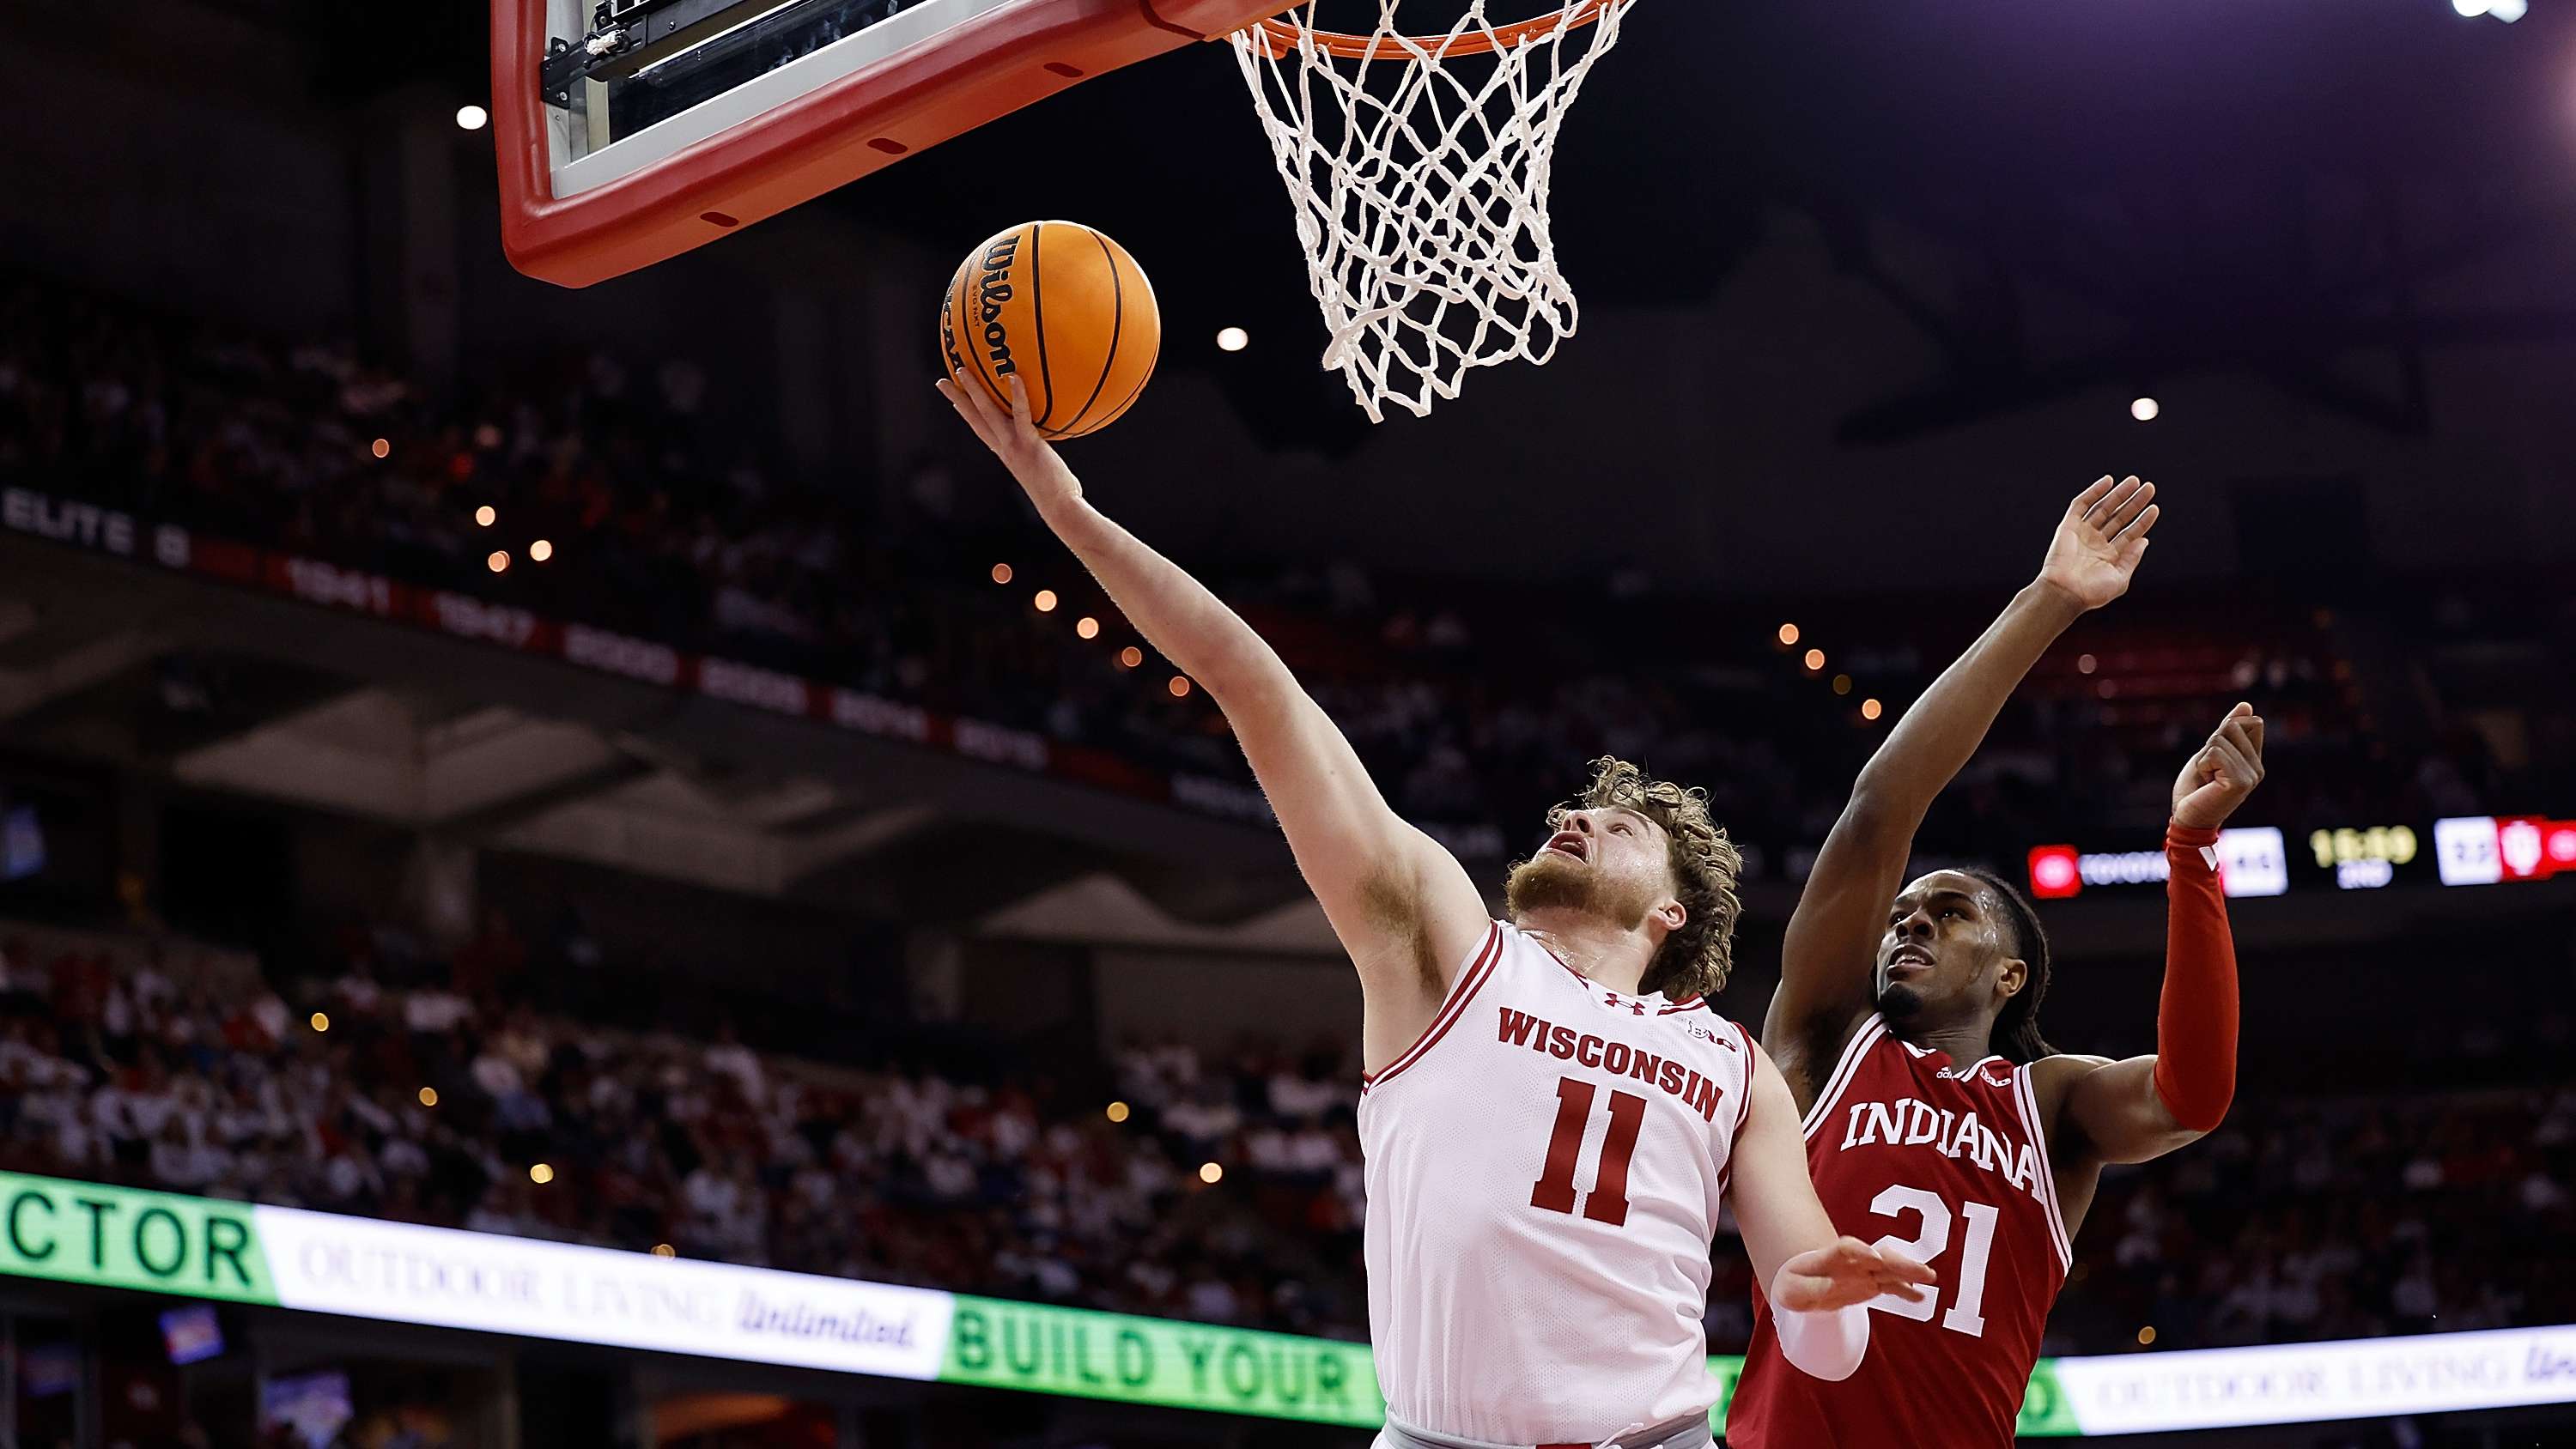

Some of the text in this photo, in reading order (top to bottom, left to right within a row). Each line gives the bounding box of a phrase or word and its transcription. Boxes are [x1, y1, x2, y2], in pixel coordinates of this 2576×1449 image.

[980, 234, 1022, 378] Wilson
[3, 487, 135, 556] ELITE
[1498, 1006, 1724, 1123] WISCONSIN
[1530, 1076, 1647, 1227] 11
[1840, 1098, 2047, 1204] INDIANA
[8, 1191, 252, 1286] CTOR
[297, 1240, 546, 1308] OUTDOOR
[562, 1269, 720, 1330] LIVING
[1867, 1184, 1999, 1337] 21
[957, 1310, 1354, 1409] BUILD YOUR
